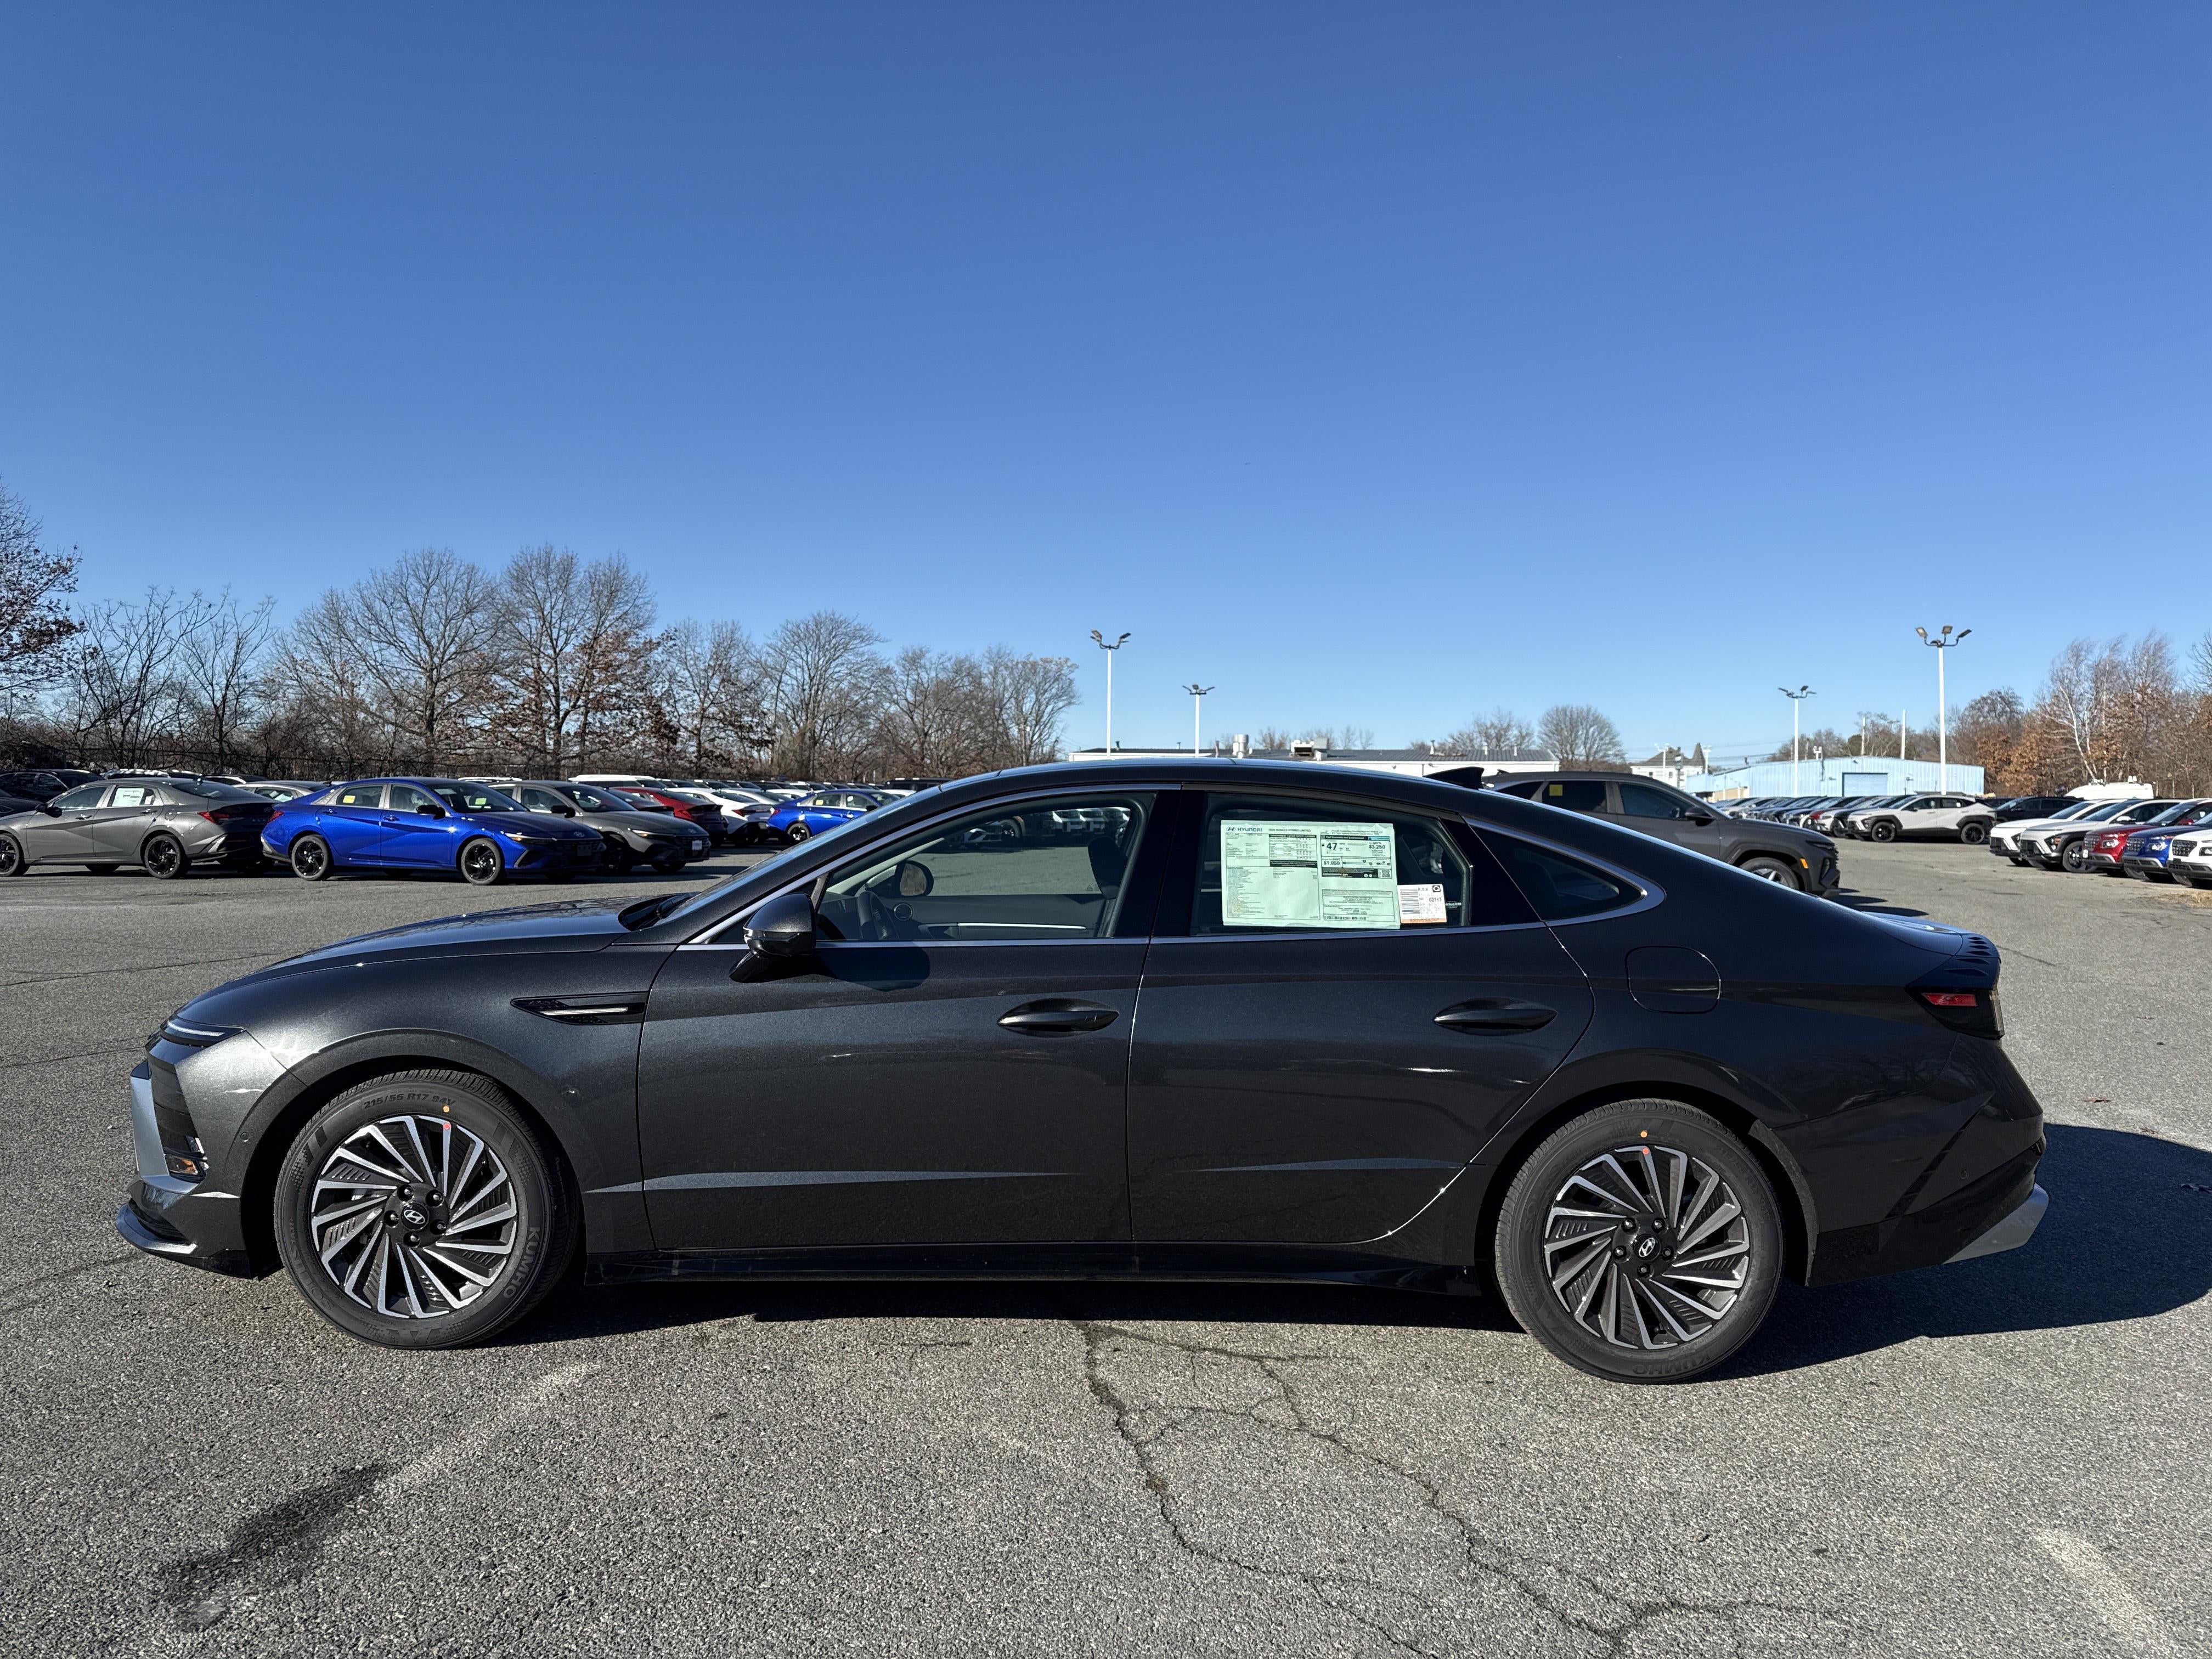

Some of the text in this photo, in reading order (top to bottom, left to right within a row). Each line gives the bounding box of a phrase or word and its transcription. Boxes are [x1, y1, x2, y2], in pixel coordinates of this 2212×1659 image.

[1326, 842, 1338, 850] 47
[364, 1093, 404, 1109] 215/55
[431, 1095, 457, 1106] 94V
[503, 1226, 541, 1299] KUMHO
[1632, 1351, 1711, 1375] KUMHO
